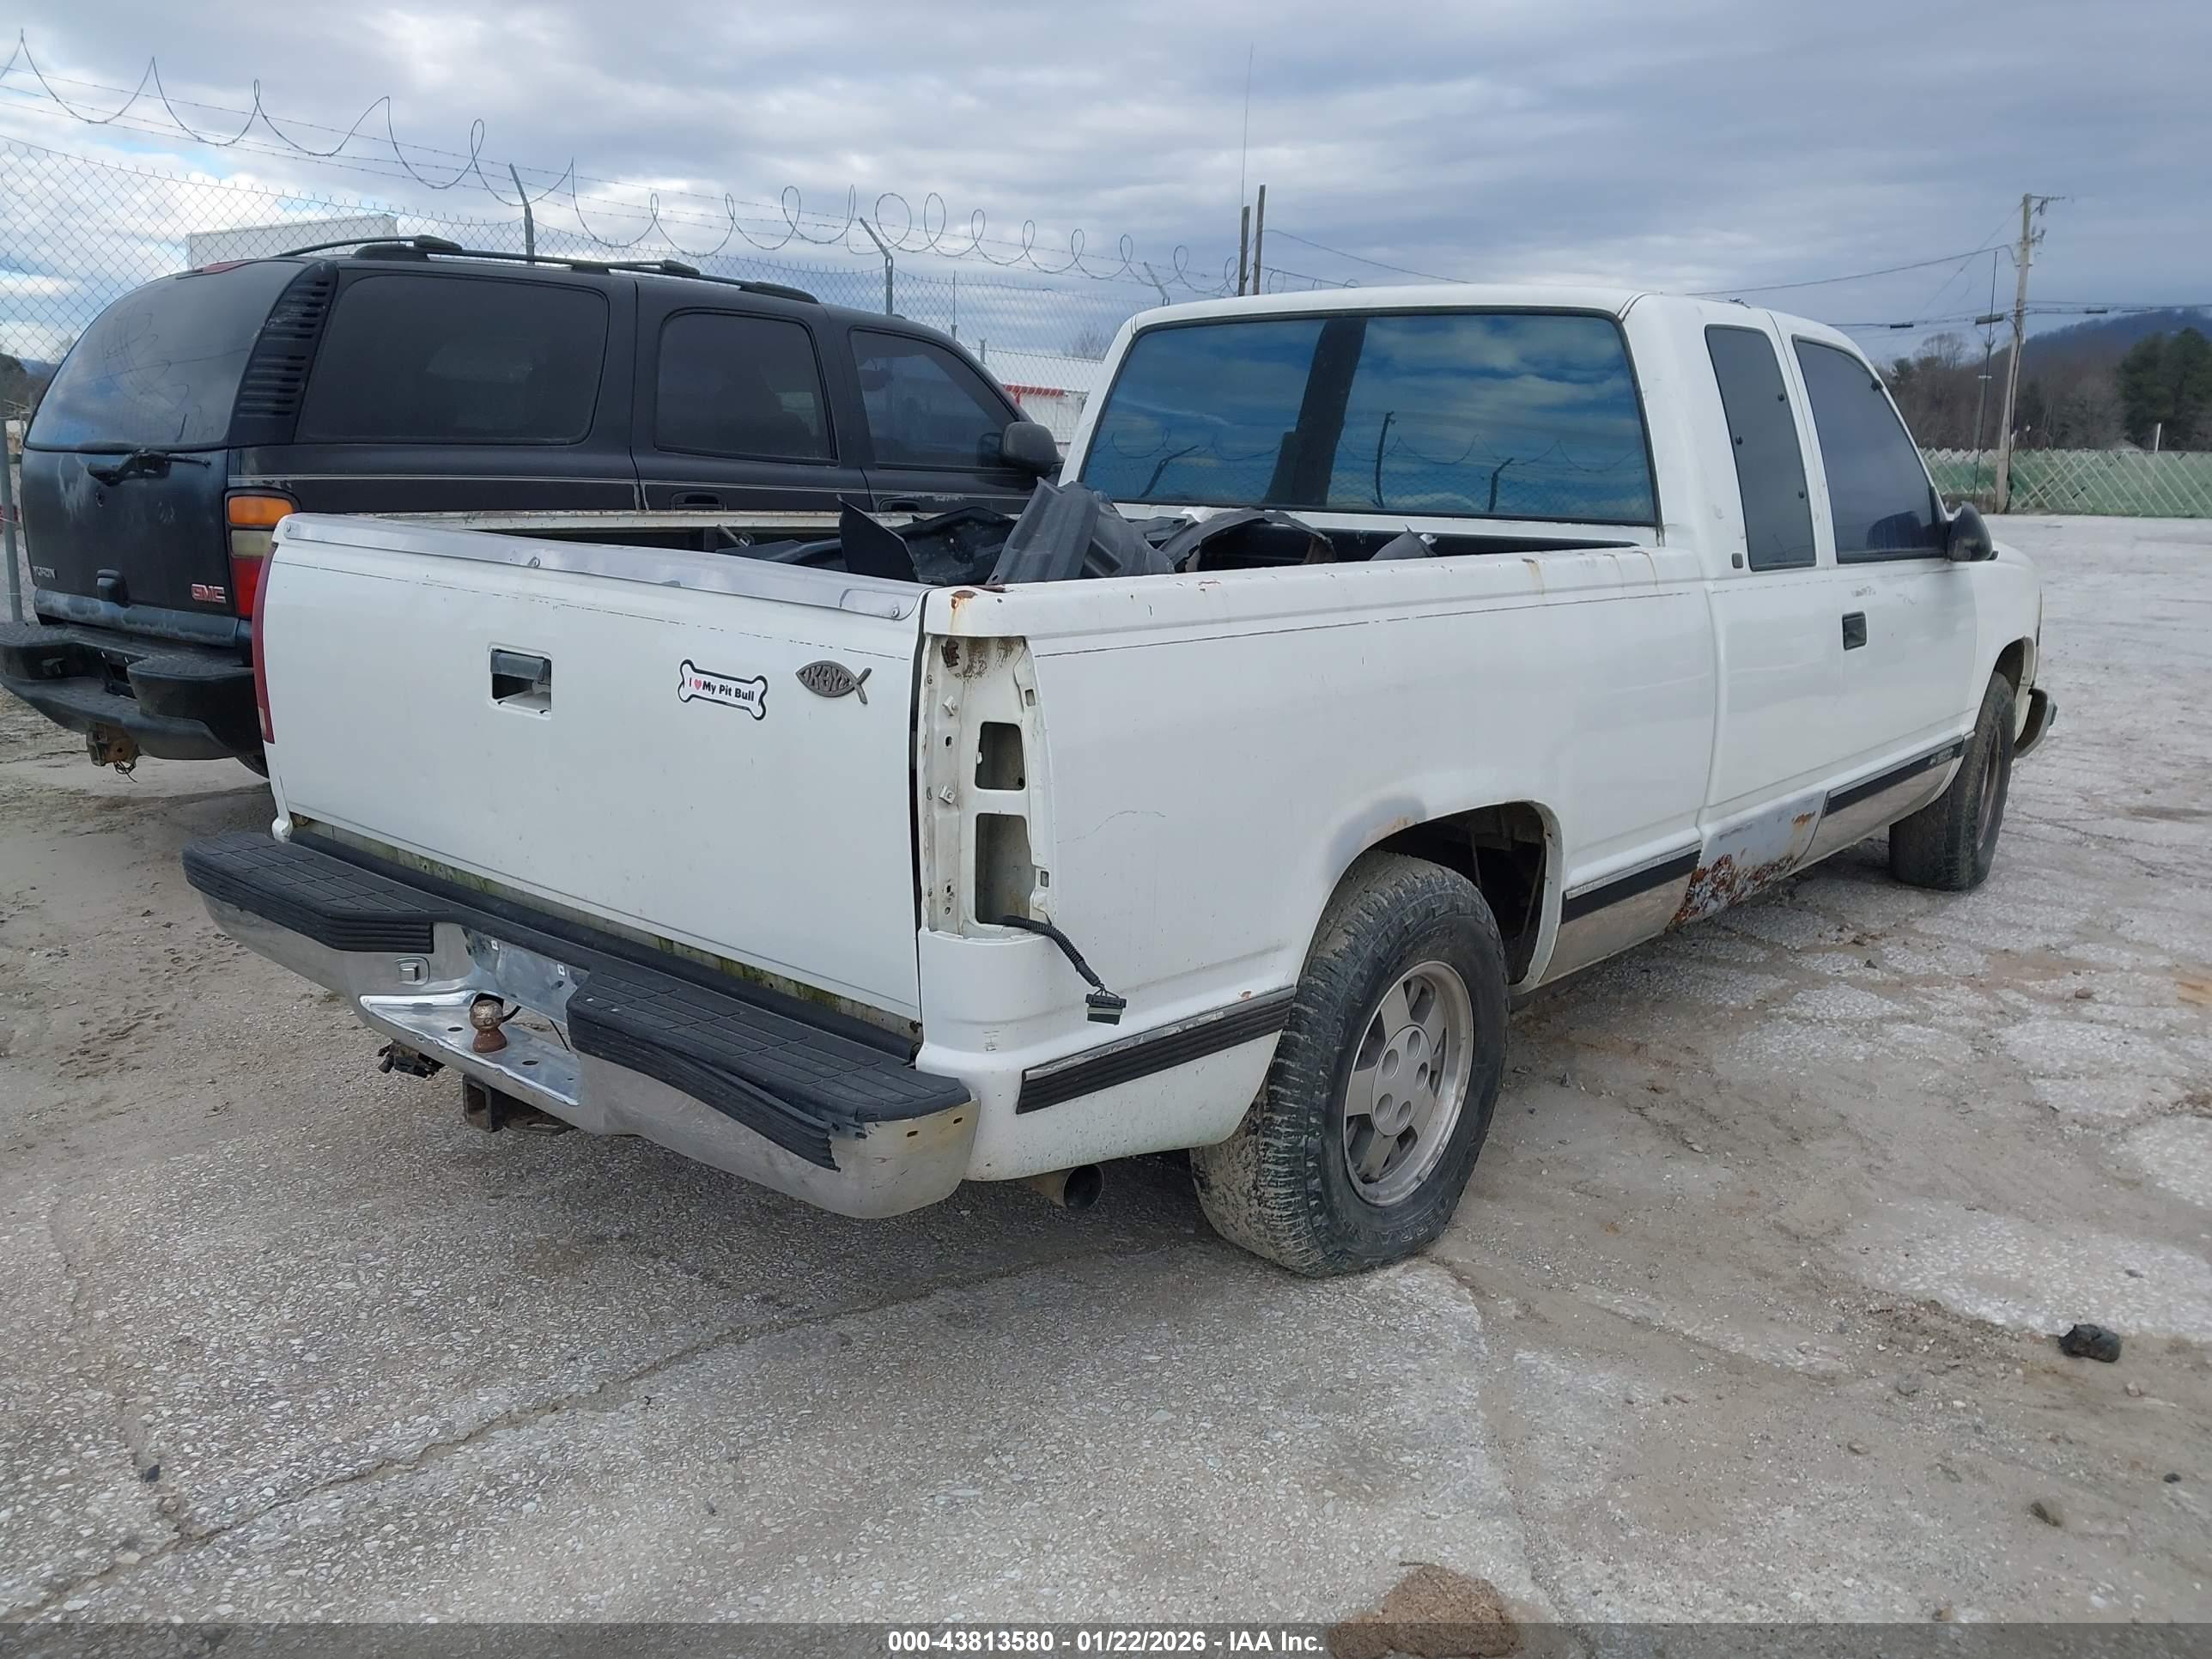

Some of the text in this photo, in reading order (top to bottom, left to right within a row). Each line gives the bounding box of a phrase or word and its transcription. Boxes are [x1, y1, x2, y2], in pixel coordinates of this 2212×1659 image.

[191, 583, 227, 604] GMC
[689, 677, 755, 702] I My Pit Bull
